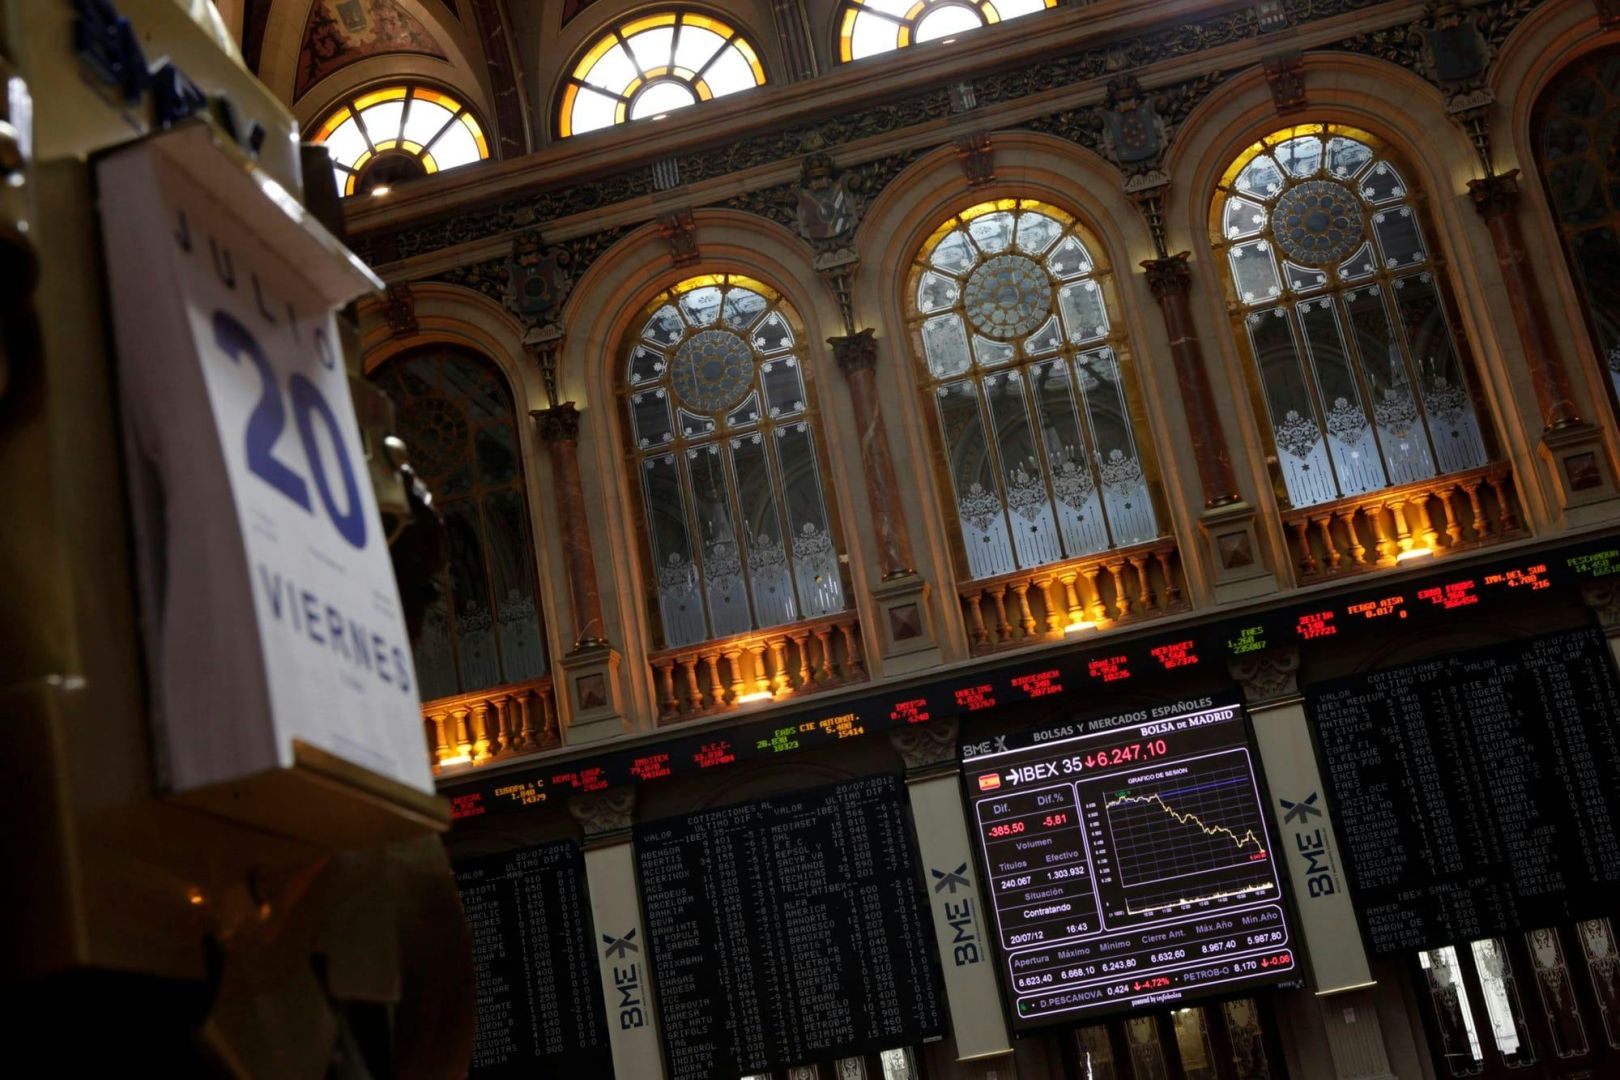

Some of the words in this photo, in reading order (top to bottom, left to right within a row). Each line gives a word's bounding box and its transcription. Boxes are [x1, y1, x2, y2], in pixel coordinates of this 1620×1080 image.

[173, 210, 335, 372] JULIO
[212, 309, 367, 550] 20
[1530, 578, 1551, 590] 216
[1364, 605, 1394, 618] 0.017
[1379, 595, 1404, 607] AISA
[256, 563, 411, 694] VIERNES
[798, 721, 815, 732] CIE
[1032, 725, 1073, 742] BOLSAS
[1077, 723, 1084, 732] Y
[1088, 710, 1147, 730] MERCADOS
[1150, 696, 1212, 717] ESPAÑOLES
[1140, 721, 1174, 736] BOLSA
[1188, 709, 1233, 726] MADRID
[962, 741, 991, 757] BME
[1018, 761, 1059, 782] IBEX
[1061, 756, 1082, 773] 35
[1095, 739, 1167, 768] 6.247,10
[992, 802, 1010, 814] Dif.
[1036, 792, 1064, 805] Dif.%
[987, 821, 1025, 837] -385,50
[1042, 813, 1067, 827] -5,81
[1016, 836, 1052, 850] Volumen
[1045, 849, 1078, 862] Efectivo
[1296, 829, 1334, 898] BME
[1046, 866, 1084, 880] 1.303.932
[1024, 886, 1063, 900] Situación
[1023, 902, 1071, 918] Contratando
[945, 898, 979, 966] BME
[1010, 931, 1044, 944] 20/07/12
[1066, 922, 1087, 933] 16:43
[1014, 954, 1049, 968] Apertura
[1057, 945, 1090, 959] Máximo
[1141, 932, 1167, 944] Cierre
[1167, 928, 1186, 939] Ant.
[613, 963, 644, 1030] BME
